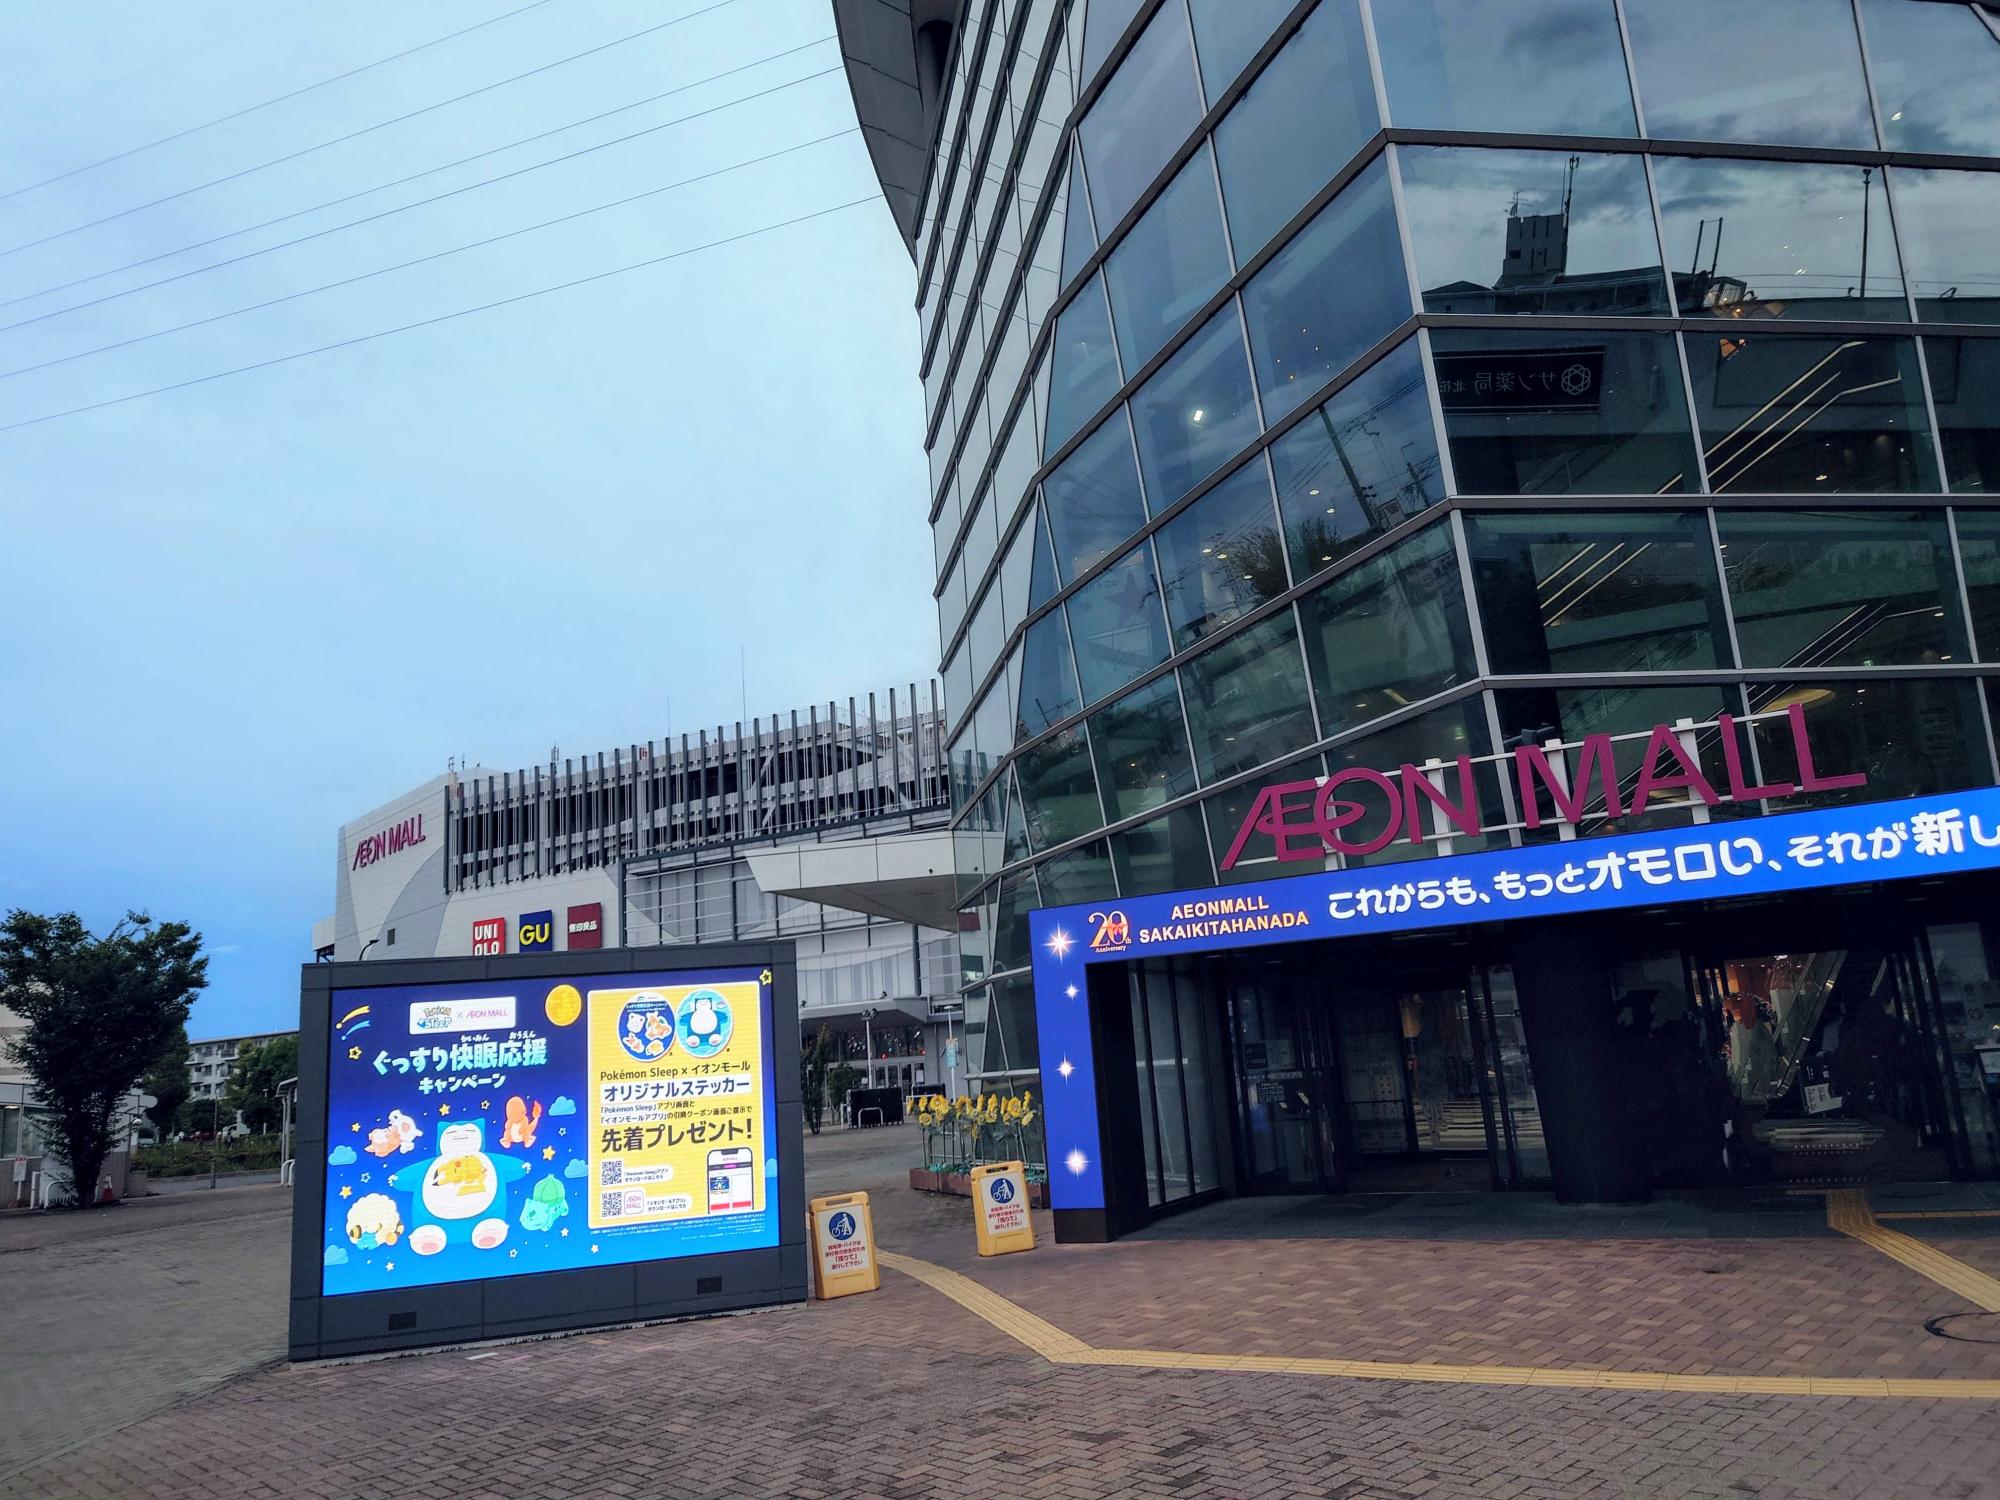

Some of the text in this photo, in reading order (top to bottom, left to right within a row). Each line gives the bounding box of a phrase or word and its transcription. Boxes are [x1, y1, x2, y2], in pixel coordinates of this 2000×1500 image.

[1515, 703, 1867, 828] MALL
[389, 813, 426, 856] MALL
[1171, 896, 1269, 920] AEONMALL
[474, 923, 499, 941] UNI
[519, 922, 550, 946] GU
[1139, 911, 1309, 943] SAKAIKITAHANADA
[1095, 945, 1127, 953] Anniversary
[488, 1008, 508, 1017] MALL
[373, 1038, 547, 1076] ぐっすり快眠応援
[600, 1069, 647, 1081] Pokémon
[650, 1067, 679, 1079] Sleep
[691, 1060, 751, 1074] イオンモール
[418, 1073, 506, 1095] キャンペーン
[604, 1077, 750, 1102] オリジナルステッカー
